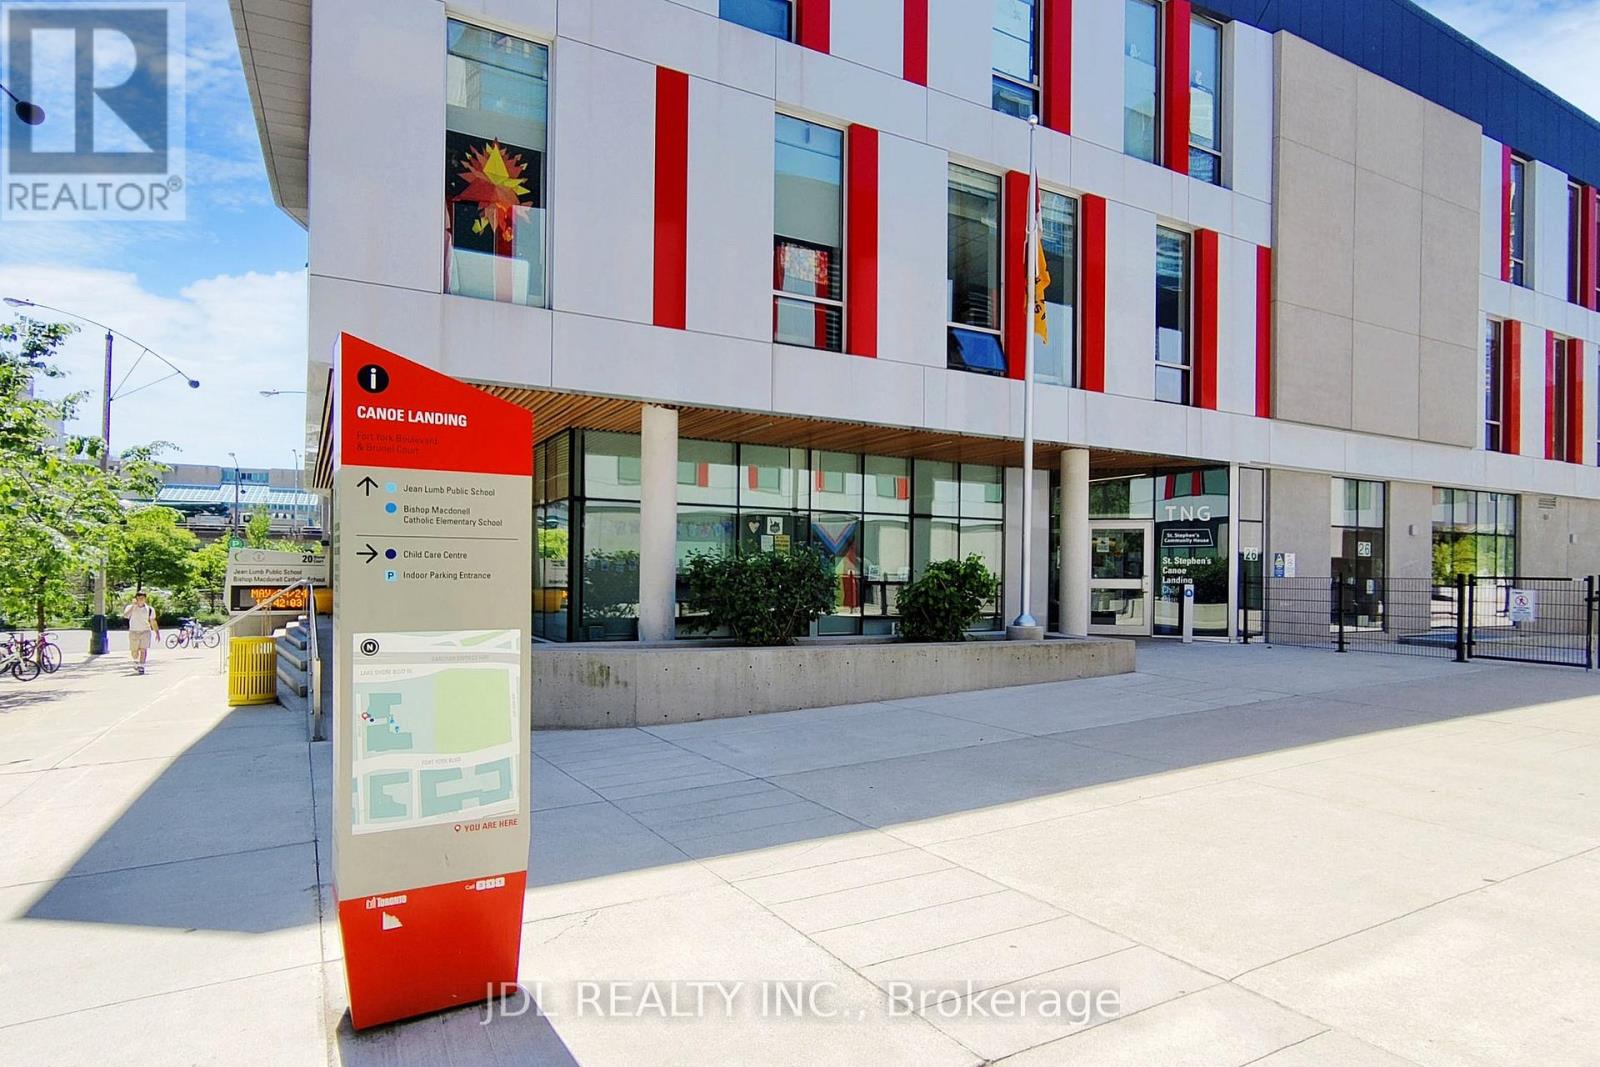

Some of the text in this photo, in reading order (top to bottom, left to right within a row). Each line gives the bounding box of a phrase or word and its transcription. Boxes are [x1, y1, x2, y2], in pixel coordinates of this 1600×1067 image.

[356, 406, 467, 427] CANOE LANDING
[403, 484, 495, 496] Jean Lumb Public School
[404, 505, 470, 514] Bishop Macdonell
[1165, 506, 1210, 522] TNG
[404, 516, 502, 527] Catholic Elementary School
[1358, 542, 1370, 556] 26
[302, 555, 313, 563] 20
[404, 550, 468, 559] Child Care Centre
[1246, 550, 1256, 560] 26
[1174, 556, 1212, 566] Stephen's
[430, 572, 458, 580] Parking
[366, 643, 374, 652] N
[464, 818, 518, 832] YOU ARE HERE
